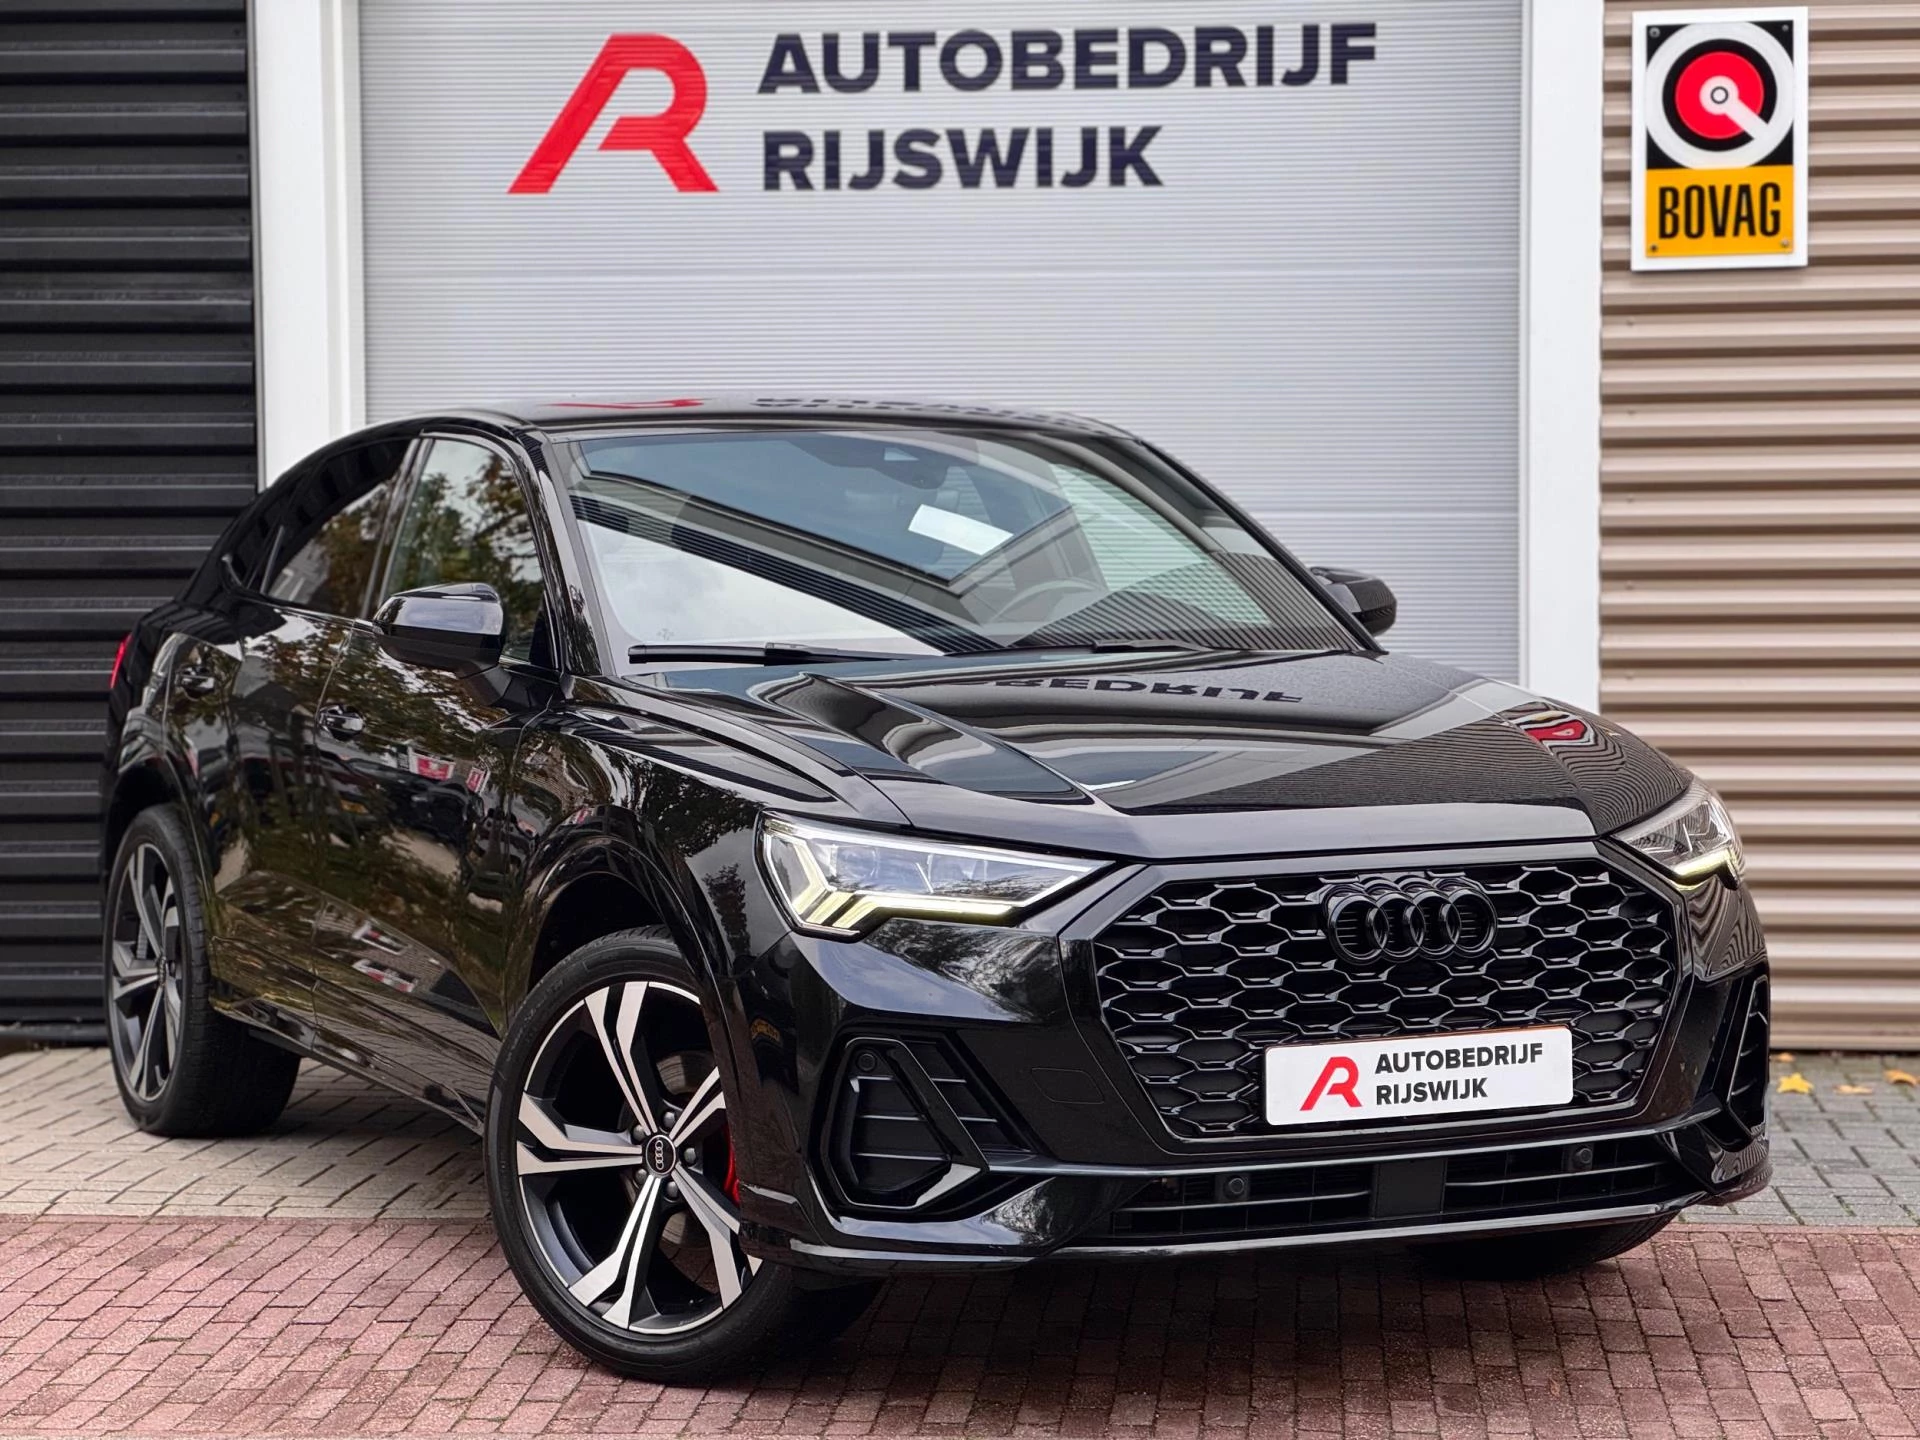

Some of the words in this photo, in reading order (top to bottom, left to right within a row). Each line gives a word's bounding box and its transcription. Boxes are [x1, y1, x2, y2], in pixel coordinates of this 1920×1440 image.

[758, 22, 1377, 94] AUTOBEDRIJF
[763, 126, 1163, 191] RIJSWIJK
[1658, 181, 1781, 240] BOVAG
[1375, 1042, 1543, 1075] AUTOBEDRIJF
[1376, 1077, 1488, 1106] RIJSWIJK
